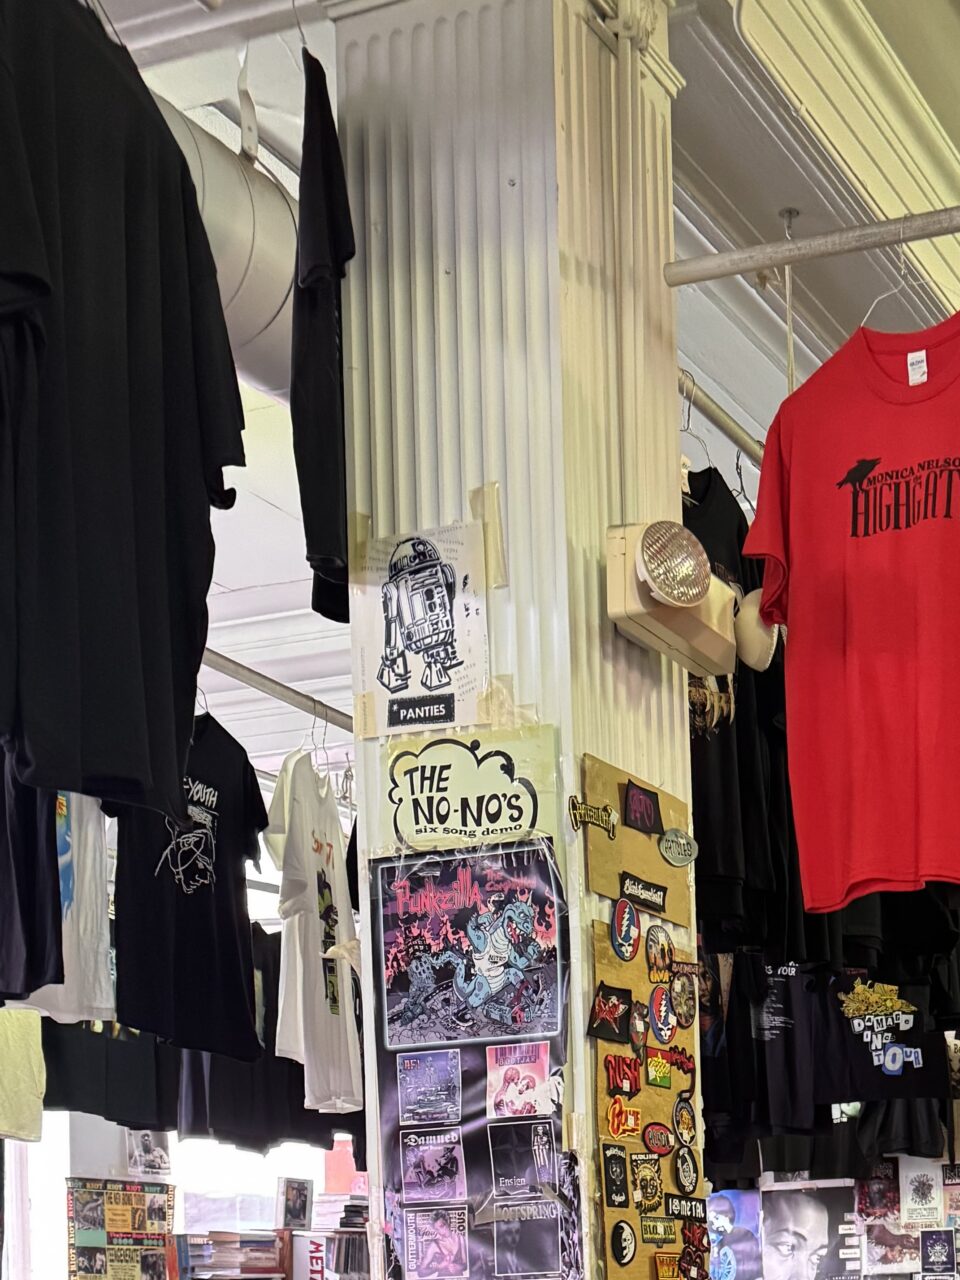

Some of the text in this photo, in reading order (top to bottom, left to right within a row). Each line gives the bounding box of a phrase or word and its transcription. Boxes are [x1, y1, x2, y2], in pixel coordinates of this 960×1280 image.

[866, 466, 916, 489] MONICA
[400, 703, 446, 720] PANTIES
[403, 763, 452, 796] THE
[188, 779, 218, 809] YOUTH
[412, 792, 524, 829] NO-NO'S
[415, 823, 523, 838] six song demo
